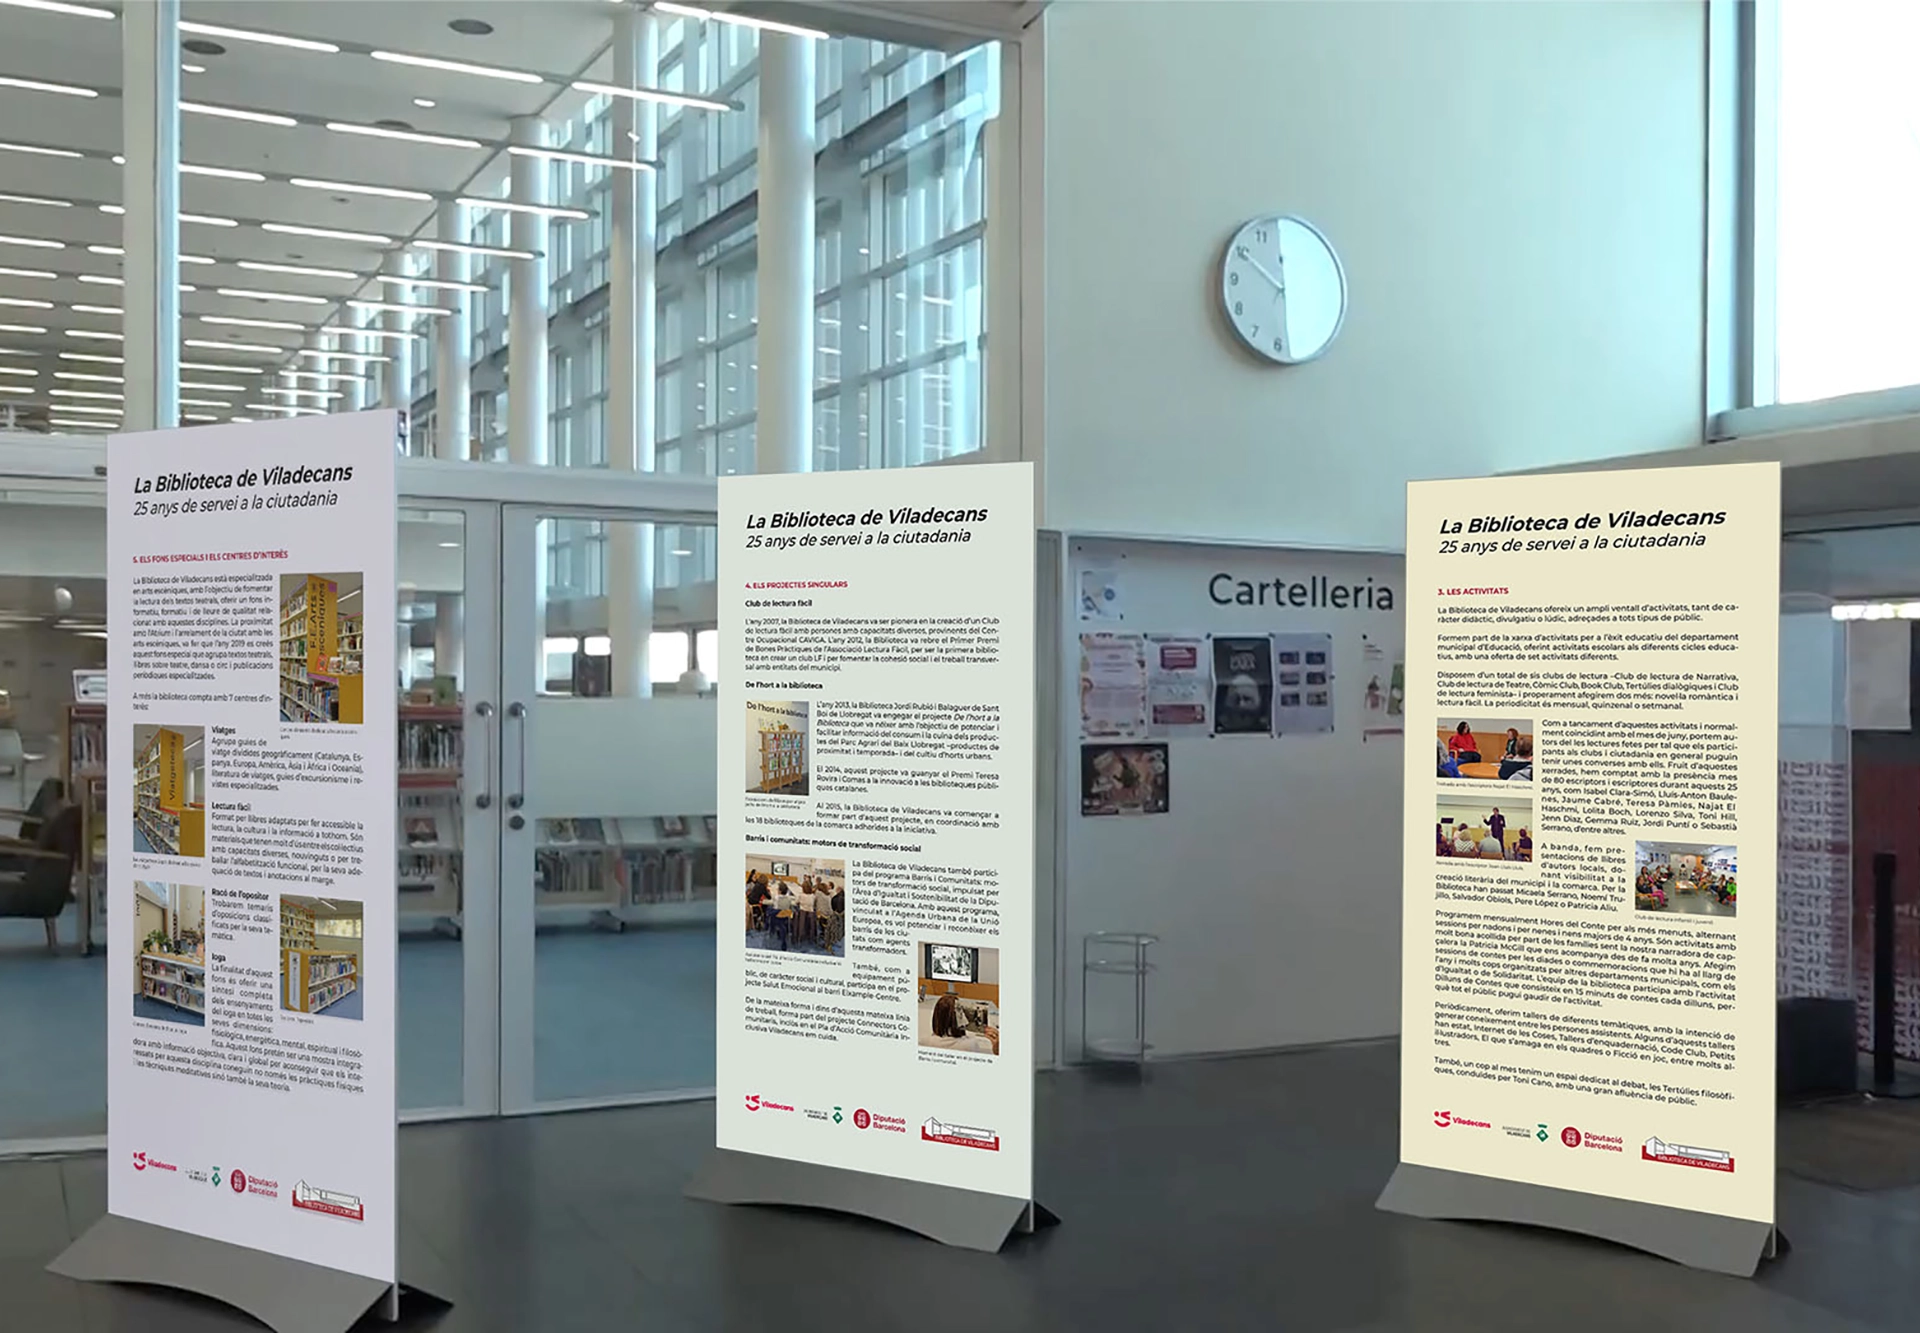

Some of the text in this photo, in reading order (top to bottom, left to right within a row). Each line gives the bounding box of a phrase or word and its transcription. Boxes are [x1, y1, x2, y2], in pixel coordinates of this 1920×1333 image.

[1256, 228, 1267, 243] 11
[1230, 272, 1238, 286] 9
[1234, 300, 1243, 316] 8
[1252, 324, 1259, 338] 7
[1274, 338, 1282, 352] 6
[134, 465, 353, 494] La Biblioteca de Viladecans
[133, 489, 338, 518] 25 anys de servei a la ciutadania
[746, 507, 988, 529] La Biblioteca de Viladecans
[1440, 510, 1727, 534] La Biblioteca de Viladecans
[746, 535, 763, 548] 25
[765, 536, 797, 551] anys
[799, 533, 818, 547] de
[819, 531, 863, 546] servei
[877, 530, 890, 545] la
[893, 528, 972, 544] ciutadania
[1439, 540, 1459, 554] 25
[1461, 541, 1498, 556] anys
[1501, 538, 1523, 552] de
[1526, 535, 1577, 551] servei
[1593, 535, 1609, 549] la
[1613, 531, 1706, 549] ciutadania
[1209, 573, 1394, 610] Cartelleria
[1437, 607, 1447, 615] La
[1448, 606, 1487, 614] Biblioteca
[1488, 606, 1499, 614] de
[1499, 606, 1543, 614] Viladecans
[1544, 605, 1571, 613] ofereix
[1586, 604, 1610, 614] ampli
[1611, 604, 1640, 612] ventall
[1641, 603, 1690, 612] d'activitats,
[1691, 604, 1710, 612] tant
[1711, 603, 1724, 611] de
[1434, 1066, 1697, 1106] ques, conduïdes per Toni Cano, amb una gran afluència de públic.
[762, 1100, 794, 1112] Viladecans
[873, 1114, 906, 1125] Diputació
[1453, 1117, 1491, 1128] Viladecans
[873, 1122, 906, 1132] Barcelona
[1584, 1132, 1623, 1144] Diputació
[1584, 1141, 1622, 1152] Barcelona
